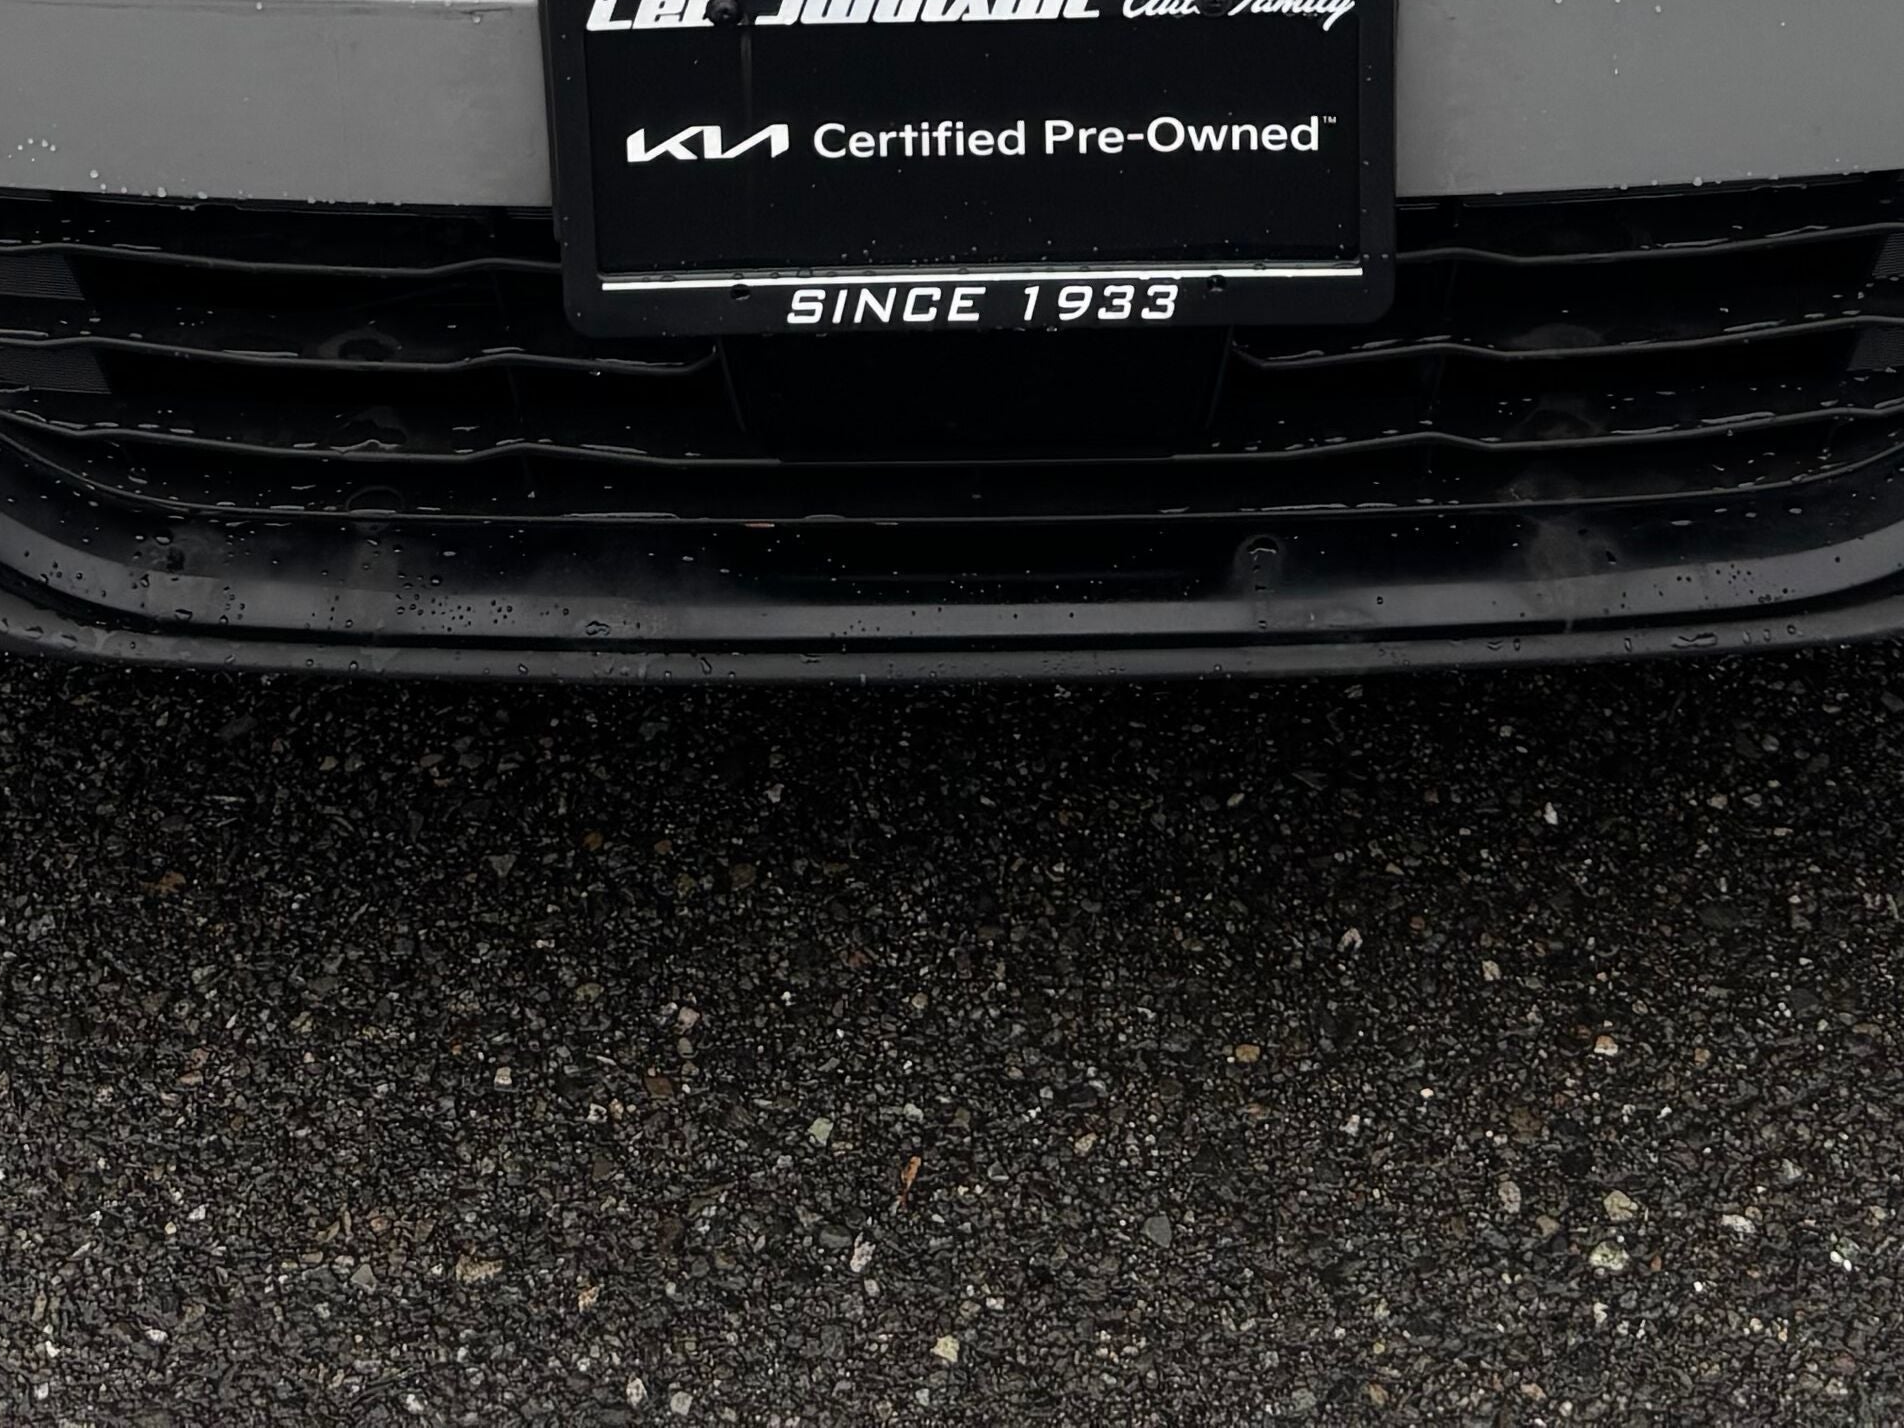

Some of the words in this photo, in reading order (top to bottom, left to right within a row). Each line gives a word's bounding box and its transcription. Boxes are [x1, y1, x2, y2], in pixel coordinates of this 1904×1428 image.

[626, 123, 789, 163] KIA
[813, 116, 1026, 158] Certified
[787, 286, 986, 324] SINCE
[1023, 284, 1179, 321] 1933
